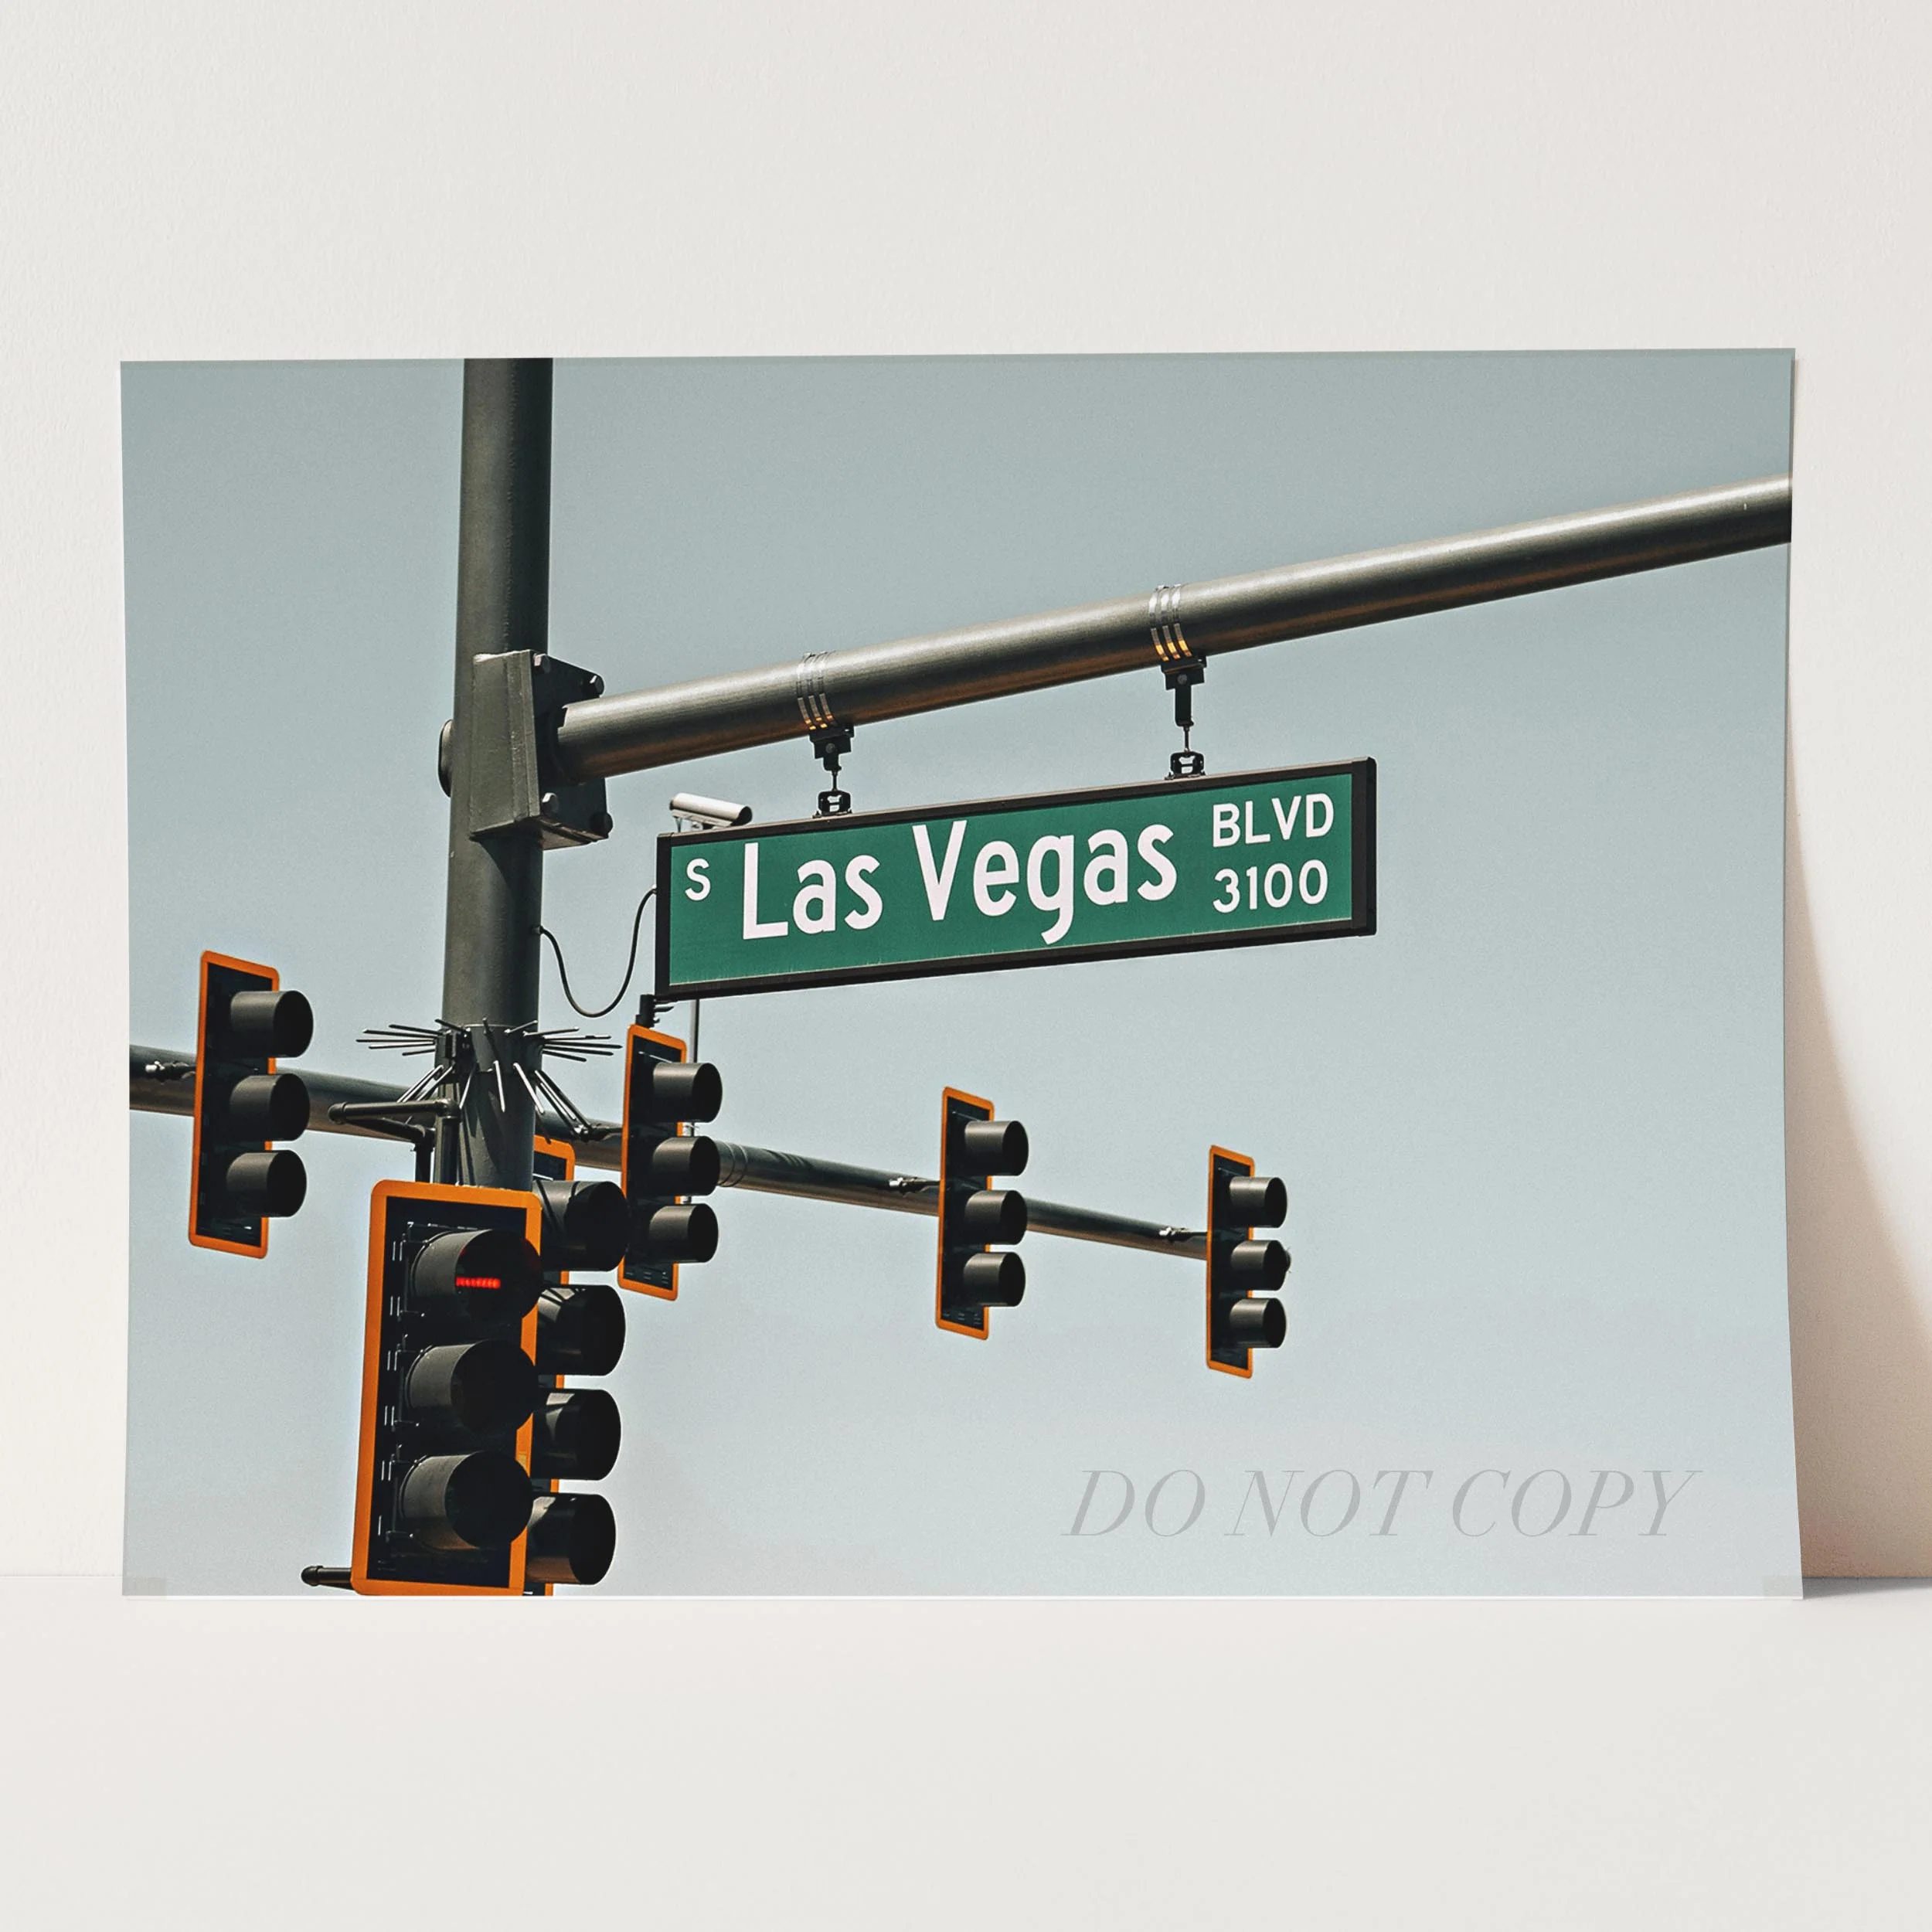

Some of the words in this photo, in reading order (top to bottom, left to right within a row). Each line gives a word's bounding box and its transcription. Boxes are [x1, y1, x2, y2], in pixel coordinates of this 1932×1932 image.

[1213, 793, 1334, 848] BLVD
[685, 858, 711, 901] S
[743, 842, 883, 940] Las
[912, 819, 1177, 945] Vegas
[1213, 859, 1328, 913] 3100
